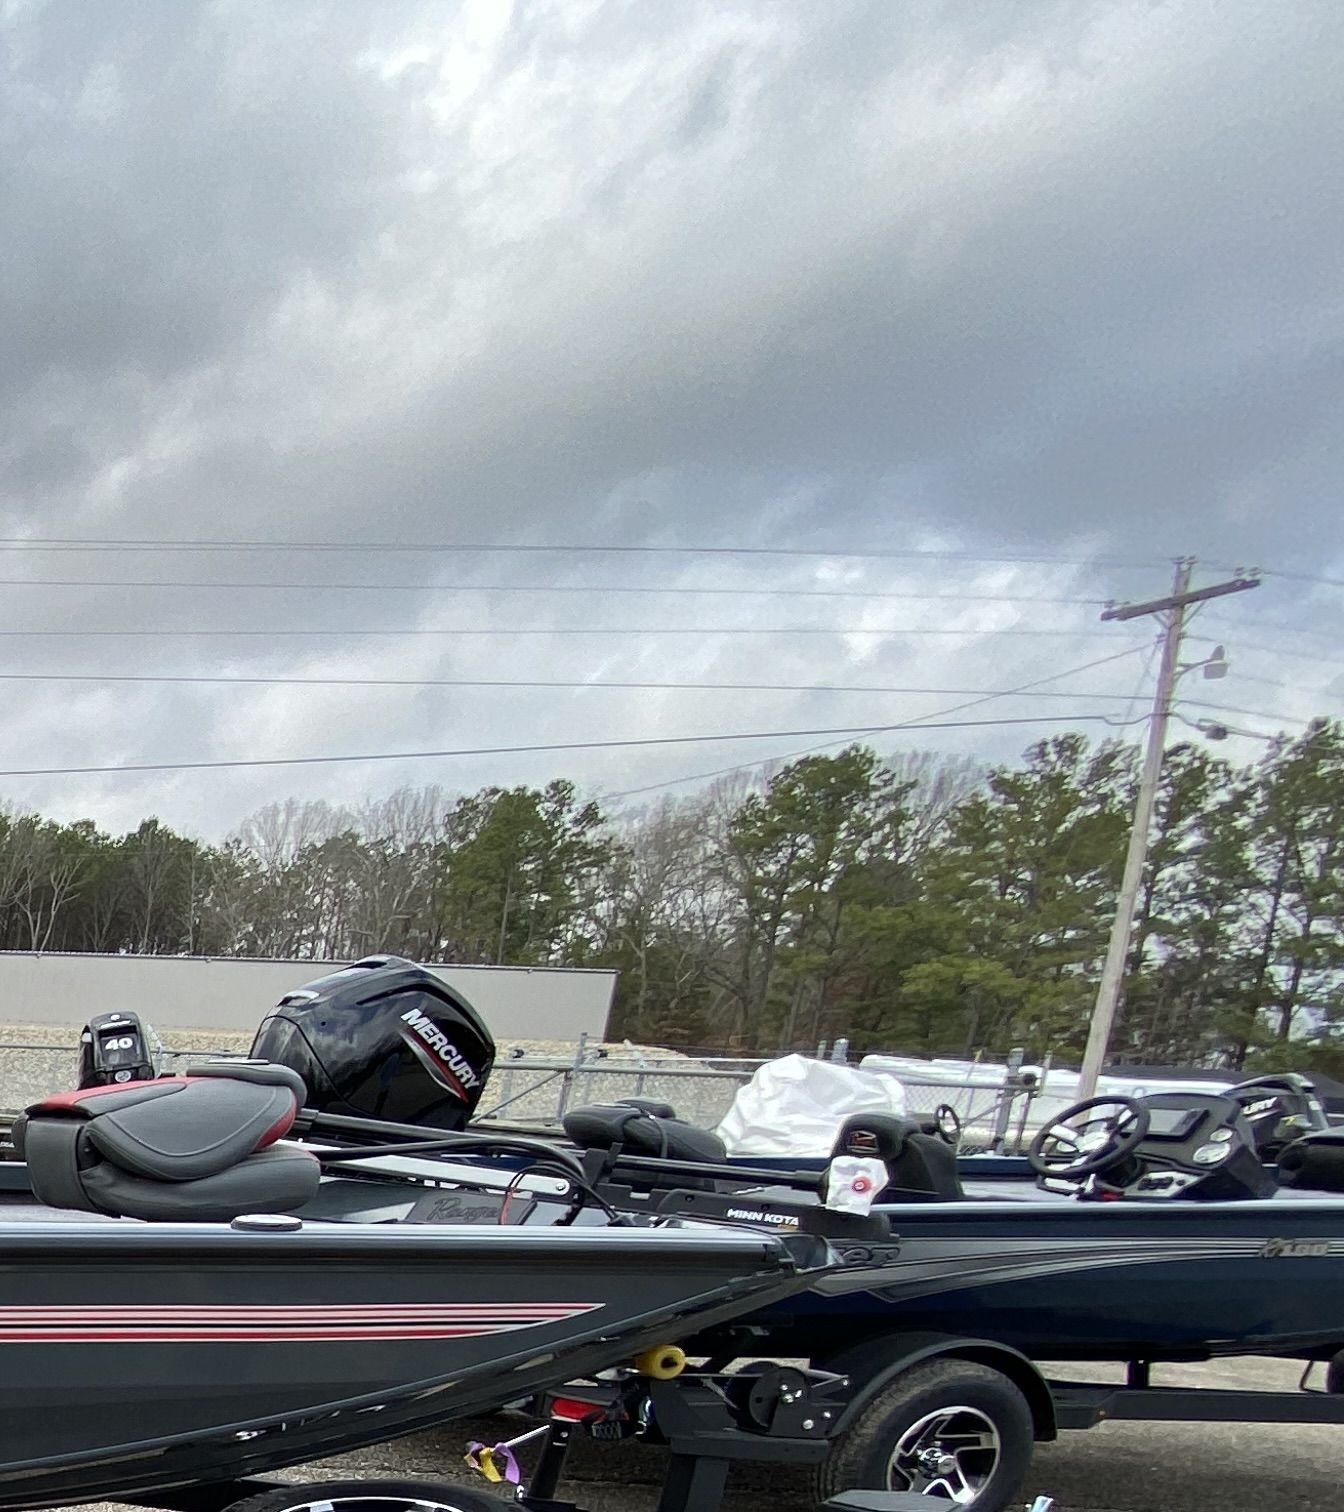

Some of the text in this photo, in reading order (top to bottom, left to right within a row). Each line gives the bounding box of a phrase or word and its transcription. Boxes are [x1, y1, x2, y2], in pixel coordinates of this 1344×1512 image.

[105, 1037, 133, 1051] 40
[400, 1008, 480, 1089] MERCURY
[727, 1208, 799, 1226] MINN KOTA
